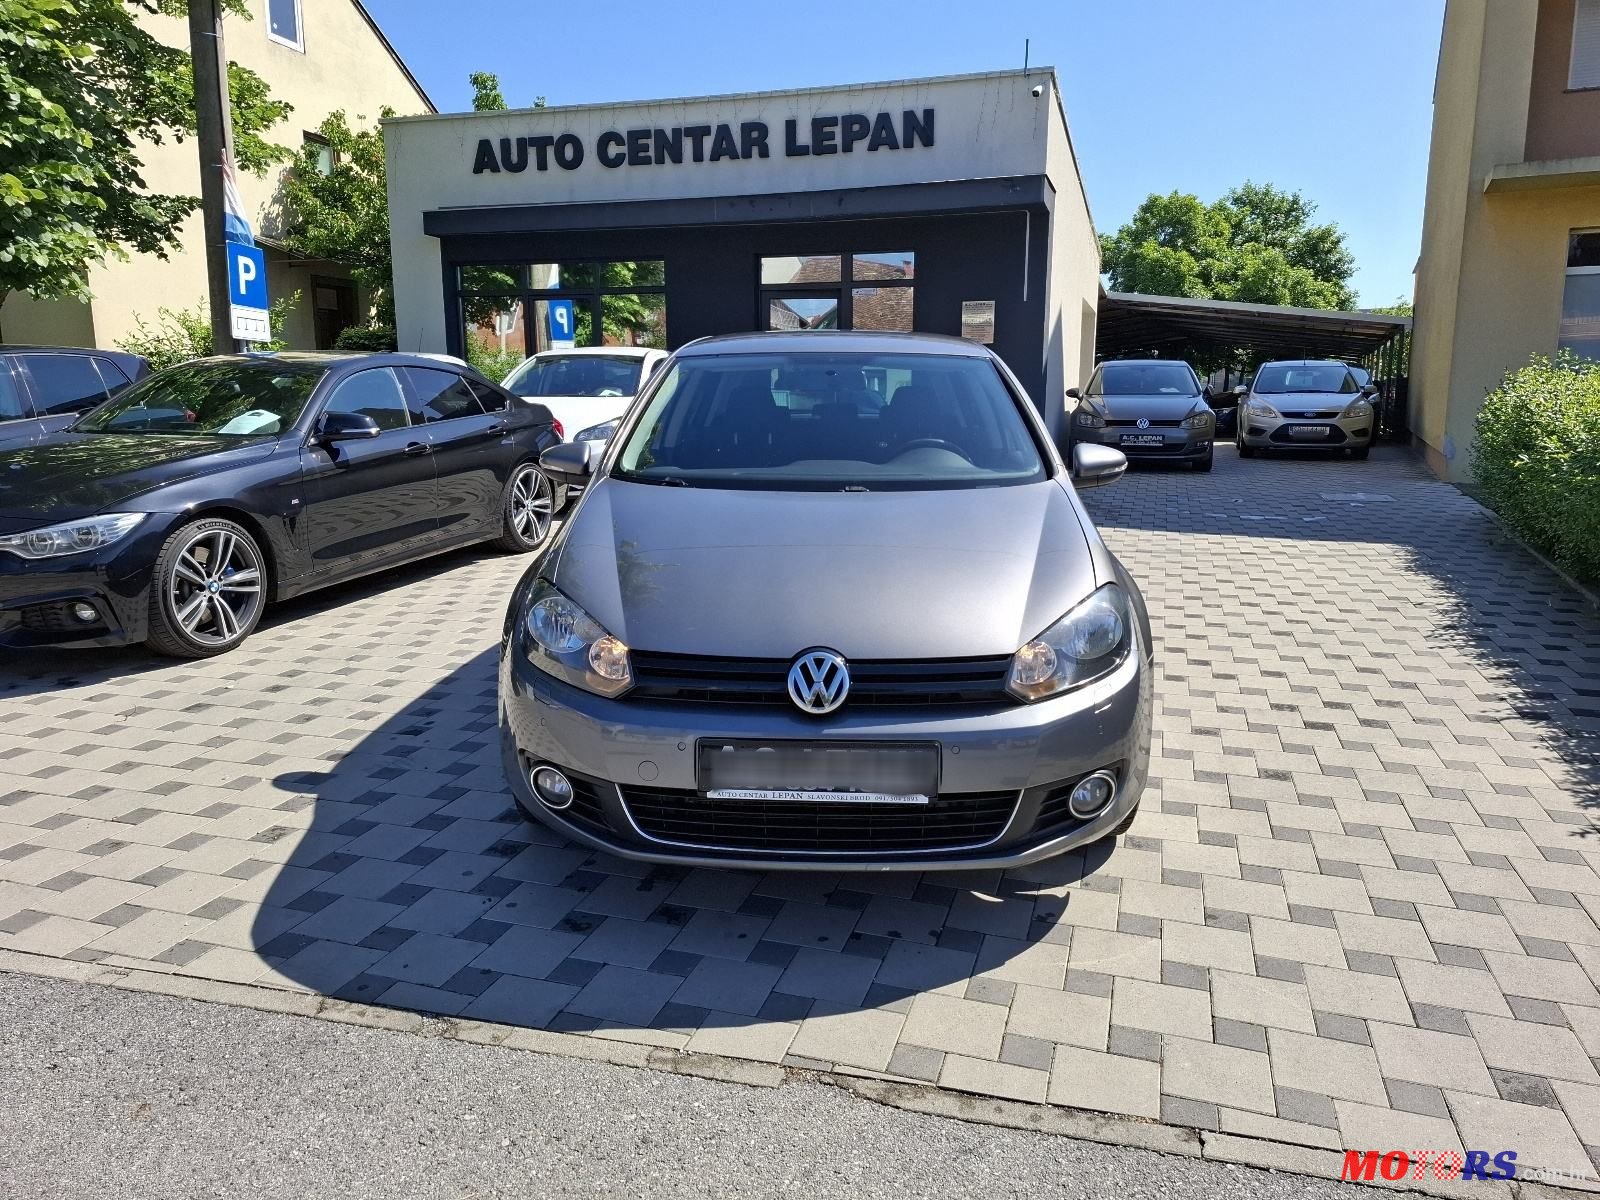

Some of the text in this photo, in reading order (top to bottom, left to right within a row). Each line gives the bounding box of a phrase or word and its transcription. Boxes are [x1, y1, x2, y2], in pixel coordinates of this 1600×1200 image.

[473, 108, 935, 174] AUTO CENTAR LEPAN
[237, 255, 256, 295] P
[772, 792, 803, 800] LEPAN
